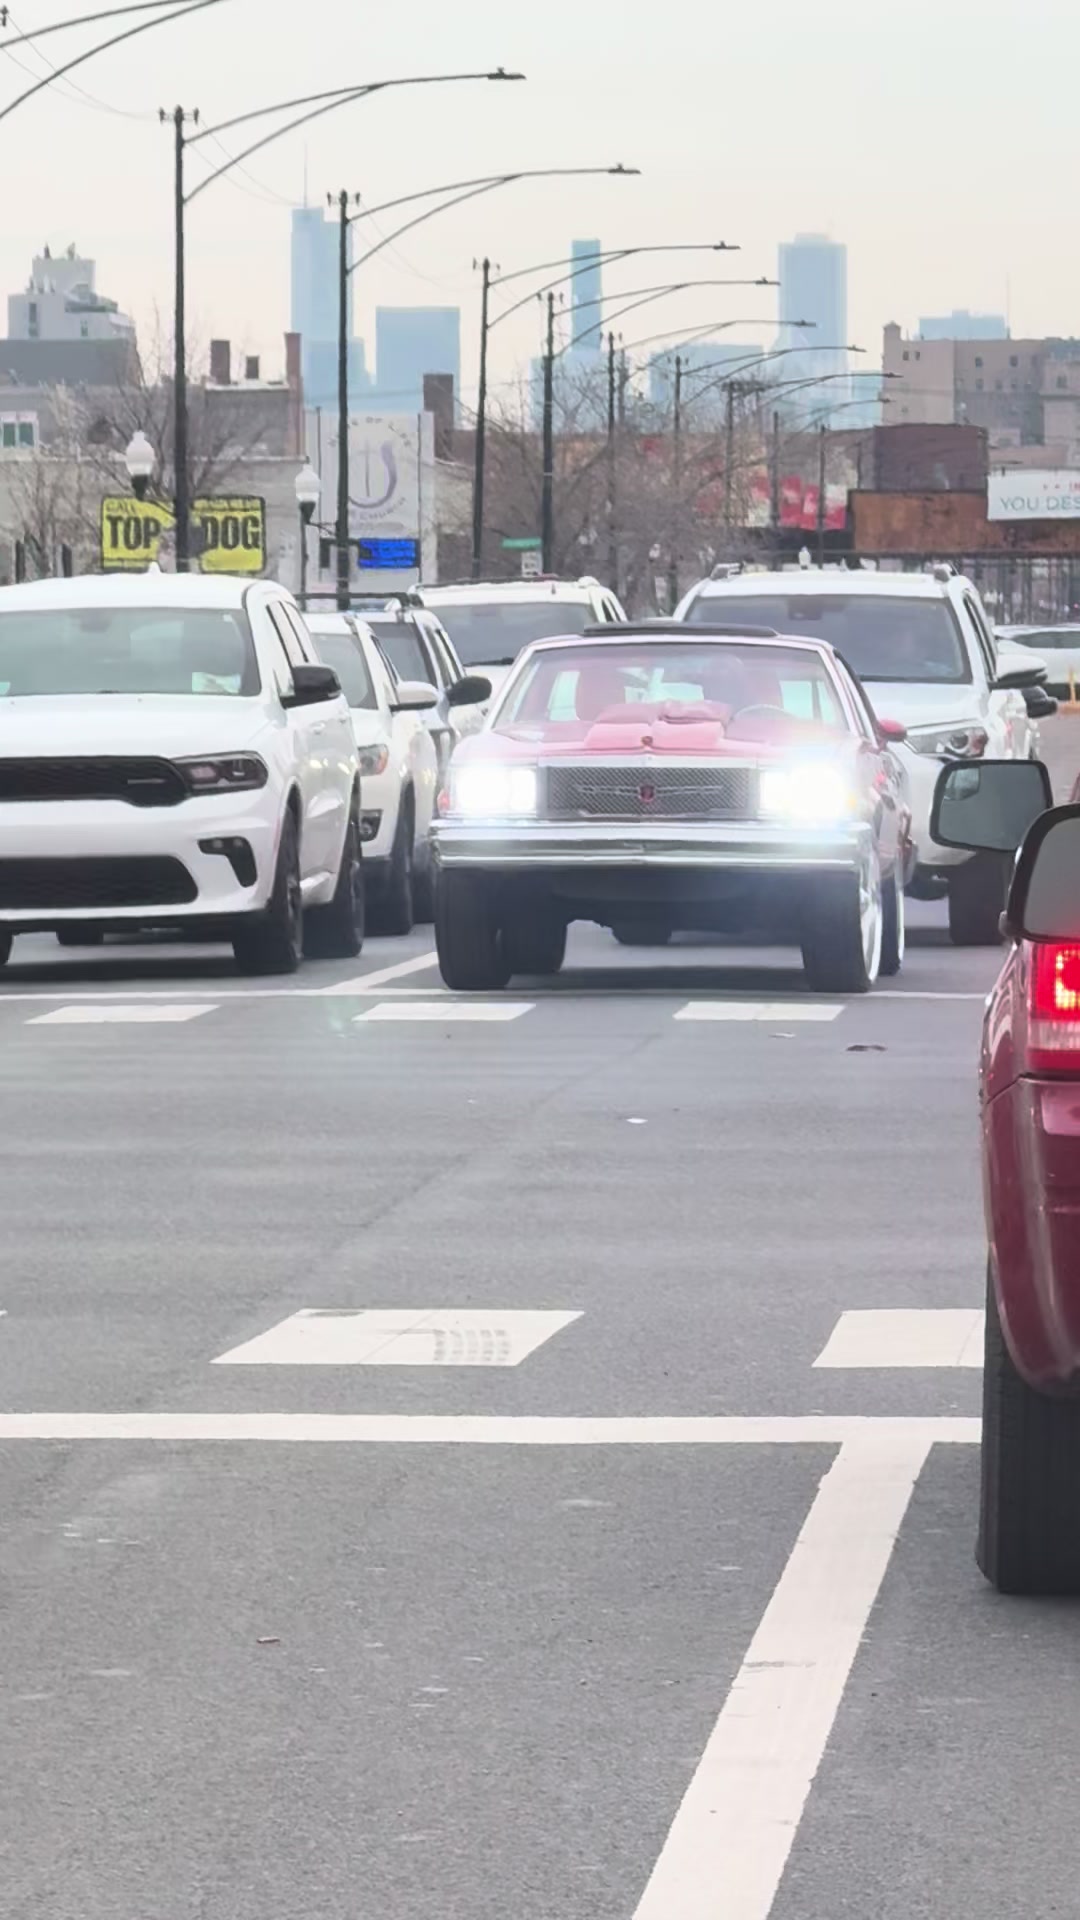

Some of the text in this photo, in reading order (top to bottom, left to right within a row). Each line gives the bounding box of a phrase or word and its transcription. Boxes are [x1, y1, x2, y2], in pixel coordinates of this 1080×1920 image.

[1000, 496, 1039, 511] YOU
[106, 515, 260, 549] TOP DOG
